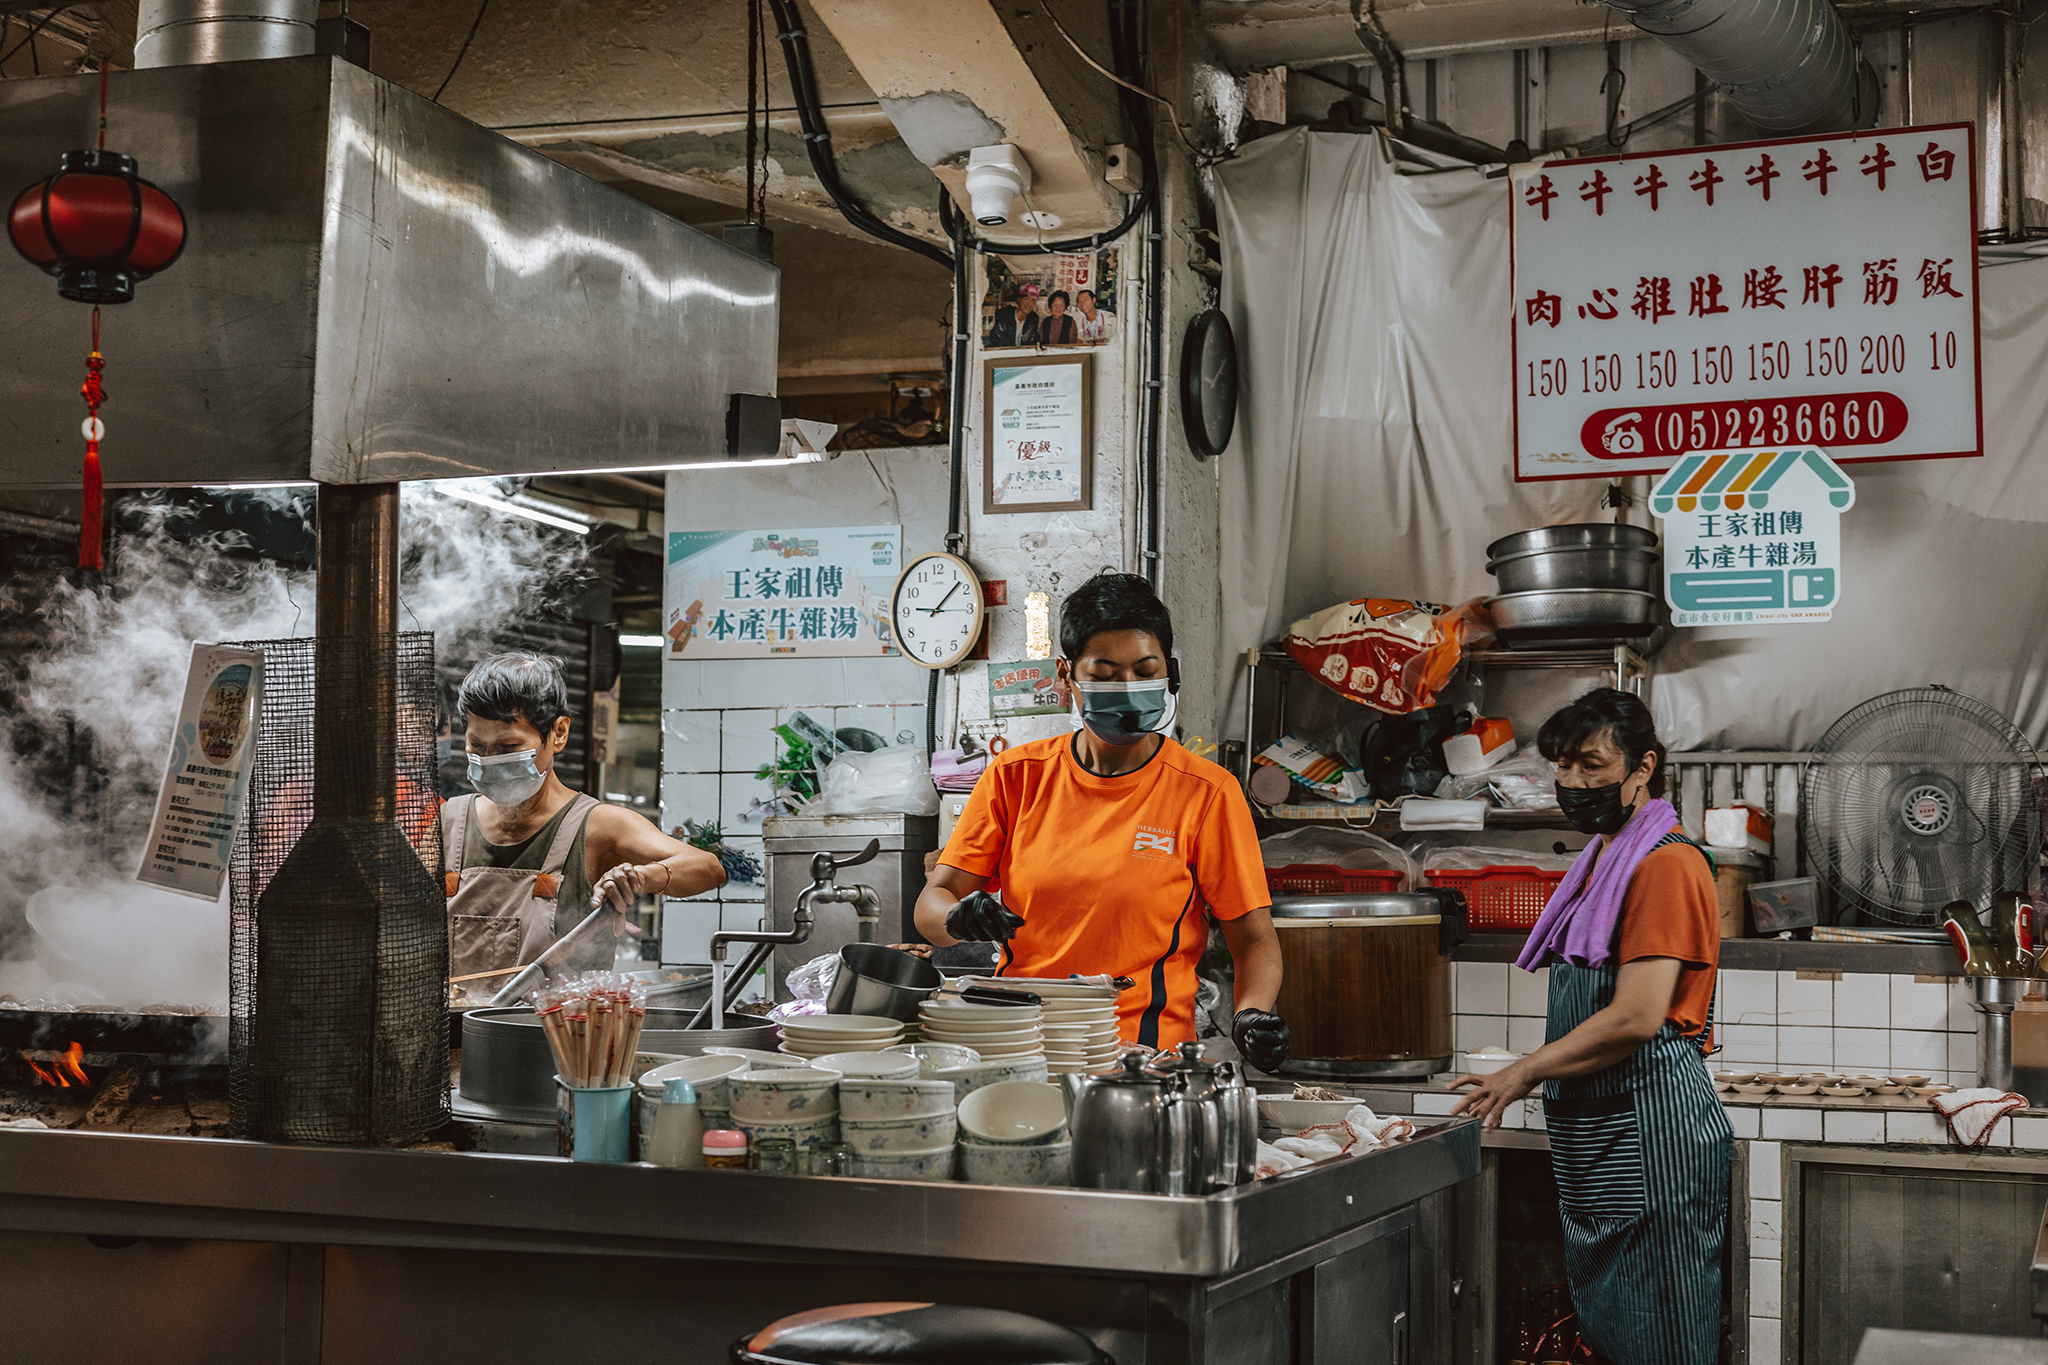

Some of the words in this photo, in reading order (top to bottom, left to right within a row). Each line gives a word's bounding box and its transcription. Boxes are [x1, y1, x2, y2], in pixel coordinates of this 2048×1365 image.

[1525, 174, 1559, 221] 牛
[1578, 169, 1613, 217] 牛
[1633, 163, 1668, 212] 牛
[1688, 158, 1724, 207] 牛
[1744, 153, 1780, 202] 牛
[1801, 148, 1838, 197] 牛
[1859, 142, 1896, 192] 牛
[1916, 141, 1956, 183] 白
[1525, 289, 1562, 329] 肉
[1577, 287, 1619, 320] 心
[1630, 276, 1676, 325] 雜
[1688, 273, 1730, 319] 肚
[1741, 265, 1788, 310] 腰
[1801, 263, 1844, 309] 肝
[1862, 258, 1899, 306] 筋
[1915, 258, 1964, 299] 飯
[1527, 357, 1567, 397] 150
[1581, 353, 1622, 393] 150
[1636, 349, 1677, 389] 150
[1691, 345, 1733, 385] 150
[1748, 340, 1790, 381] 150
[1805, 336, 1848, 377] 150
[1860, 333, 1905, 375] 200
[1929, 330, 1957, 371] 10
[1655, 400, 1885, 451] (05)2236660
[1698, 510, 1803, 538] 王家祖傳
[1685, 541, 1818, 570] 本產牛雜湯
[932, 563, 944, 576] 12
[724, 564, 844, 600] 王家祖傳
[918, 571, 928, 583] 11
[907, 587, 920, 599] 10
[963, 583, 970, 596] 2
[902, 606, 910, 619] 9
[966, 602, 974, 615] 3
[707, 605, 859, 642] 本產牛雜湯
[961, 624, 969, 636] 4
[907, 626, 915, 639] 8
[919, 641, 926, 653] 7
[934, 645, 942, 658] 6
[950, 639, 958, 652] 5
[1033, 691, 1060, 706] 牛肉
[1137, 825, 1176, 837] HERBALIFE
[1134, 832, 1175, 855] 24
